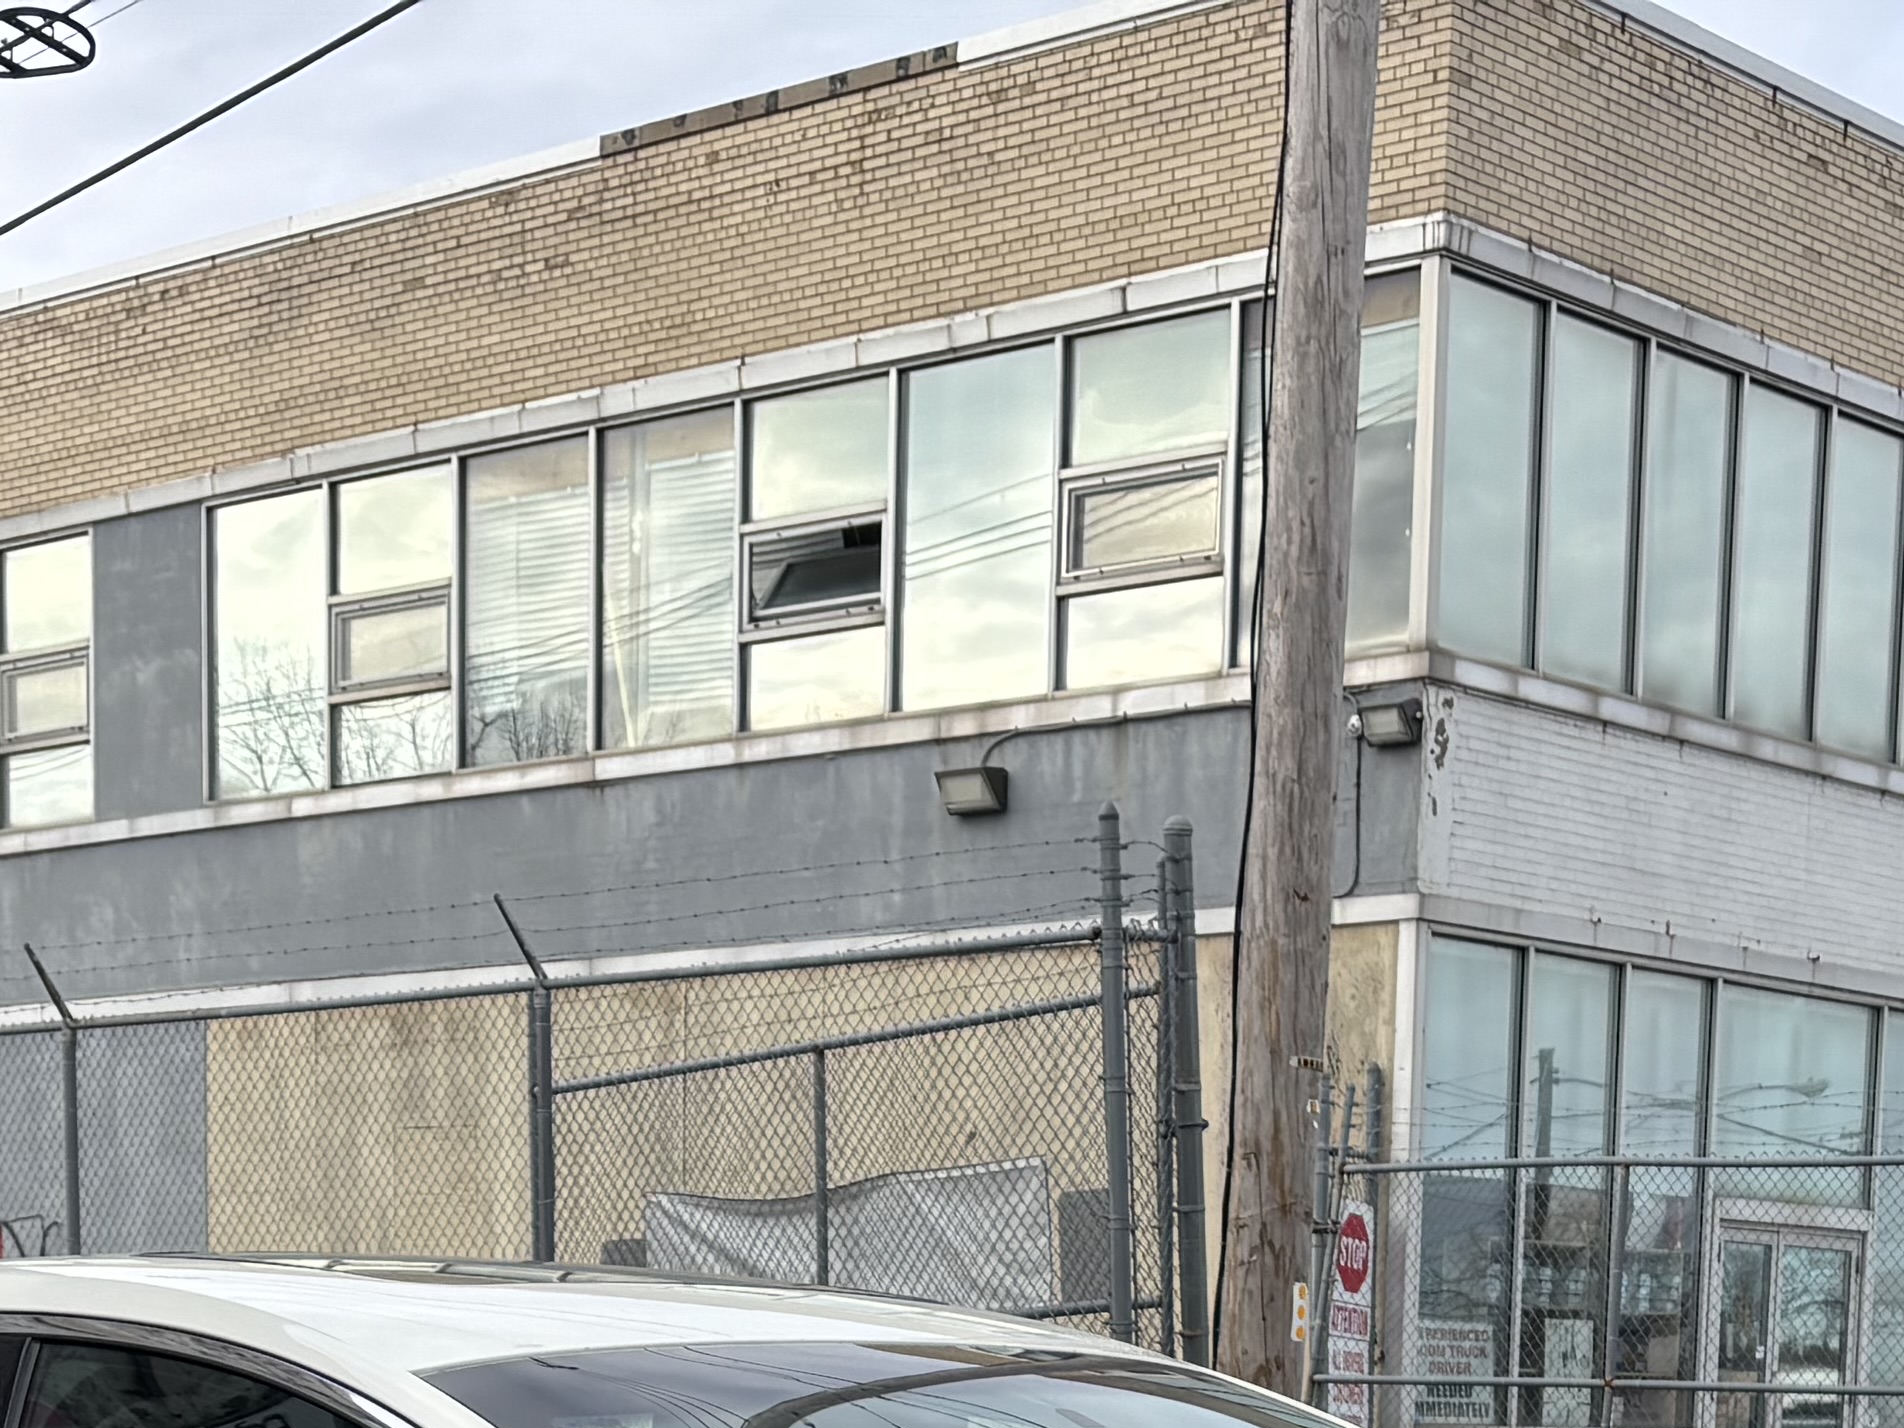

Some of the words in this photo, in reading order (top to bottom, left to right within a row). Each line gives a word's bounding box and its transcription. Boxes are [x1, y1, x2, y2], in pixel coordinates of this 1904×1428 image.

[1339, 1236, 1367, 1271] STOP
[1447, 1344, 1488, 1359] TRUCK
[1428, 1361, 1472, 1376] DRIVER
